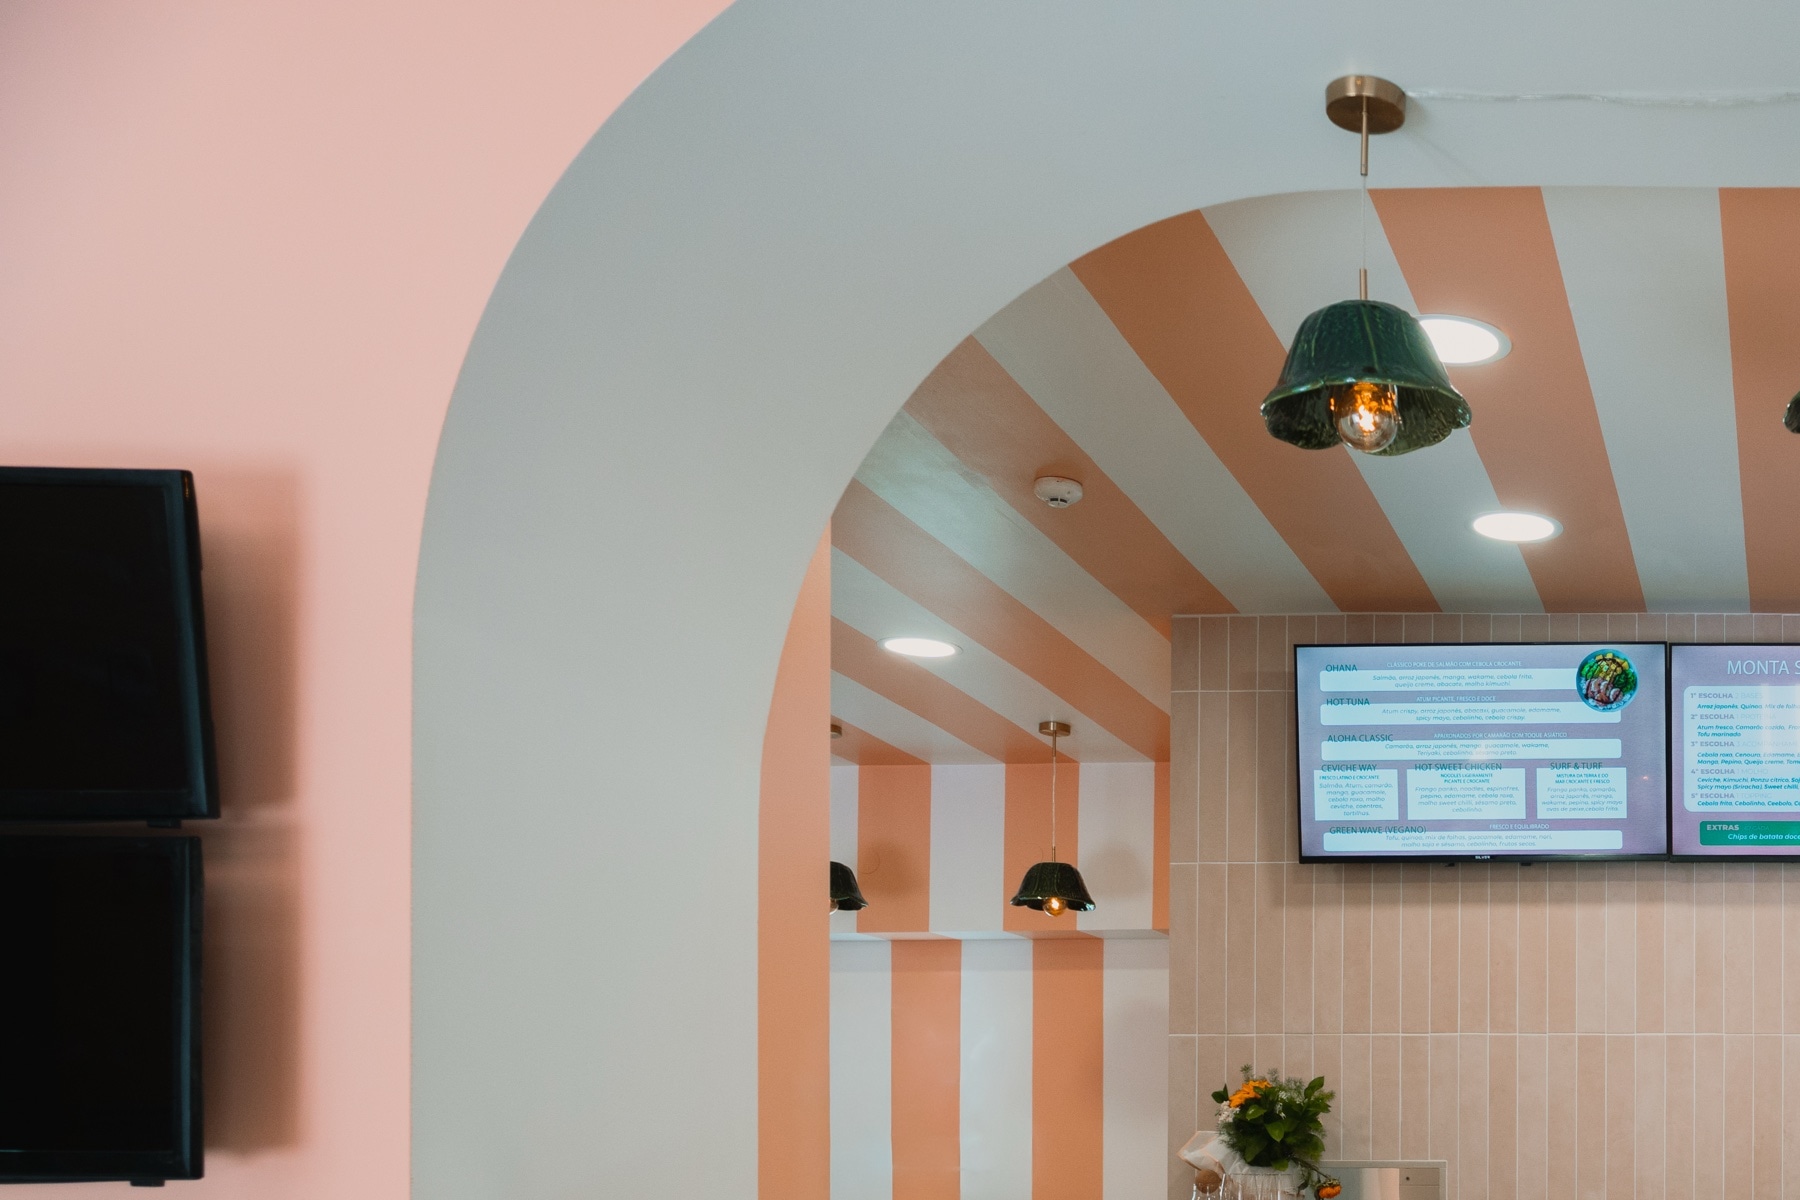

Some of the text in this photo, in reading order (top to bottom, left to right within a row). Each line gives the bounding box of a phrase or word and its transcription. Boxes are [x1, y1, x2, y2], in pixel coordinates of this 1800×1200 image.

[1727, 660, 1789, 675] MONTA
[1326, 698, 1345, 706] HOT
[1328, 734, 1393, 742] ALOHA CLASSIC
[1321, 764, 1377, 772] CEVICHE WAY
[1415, 763, 1432, 771] HOT
[1434, 763, 1462, 771] SWEET
[1550, 762, 1603, 770] SURF & TURF
[1330, 826, 1426, 834] GREEN WAVE (VEGANO)
